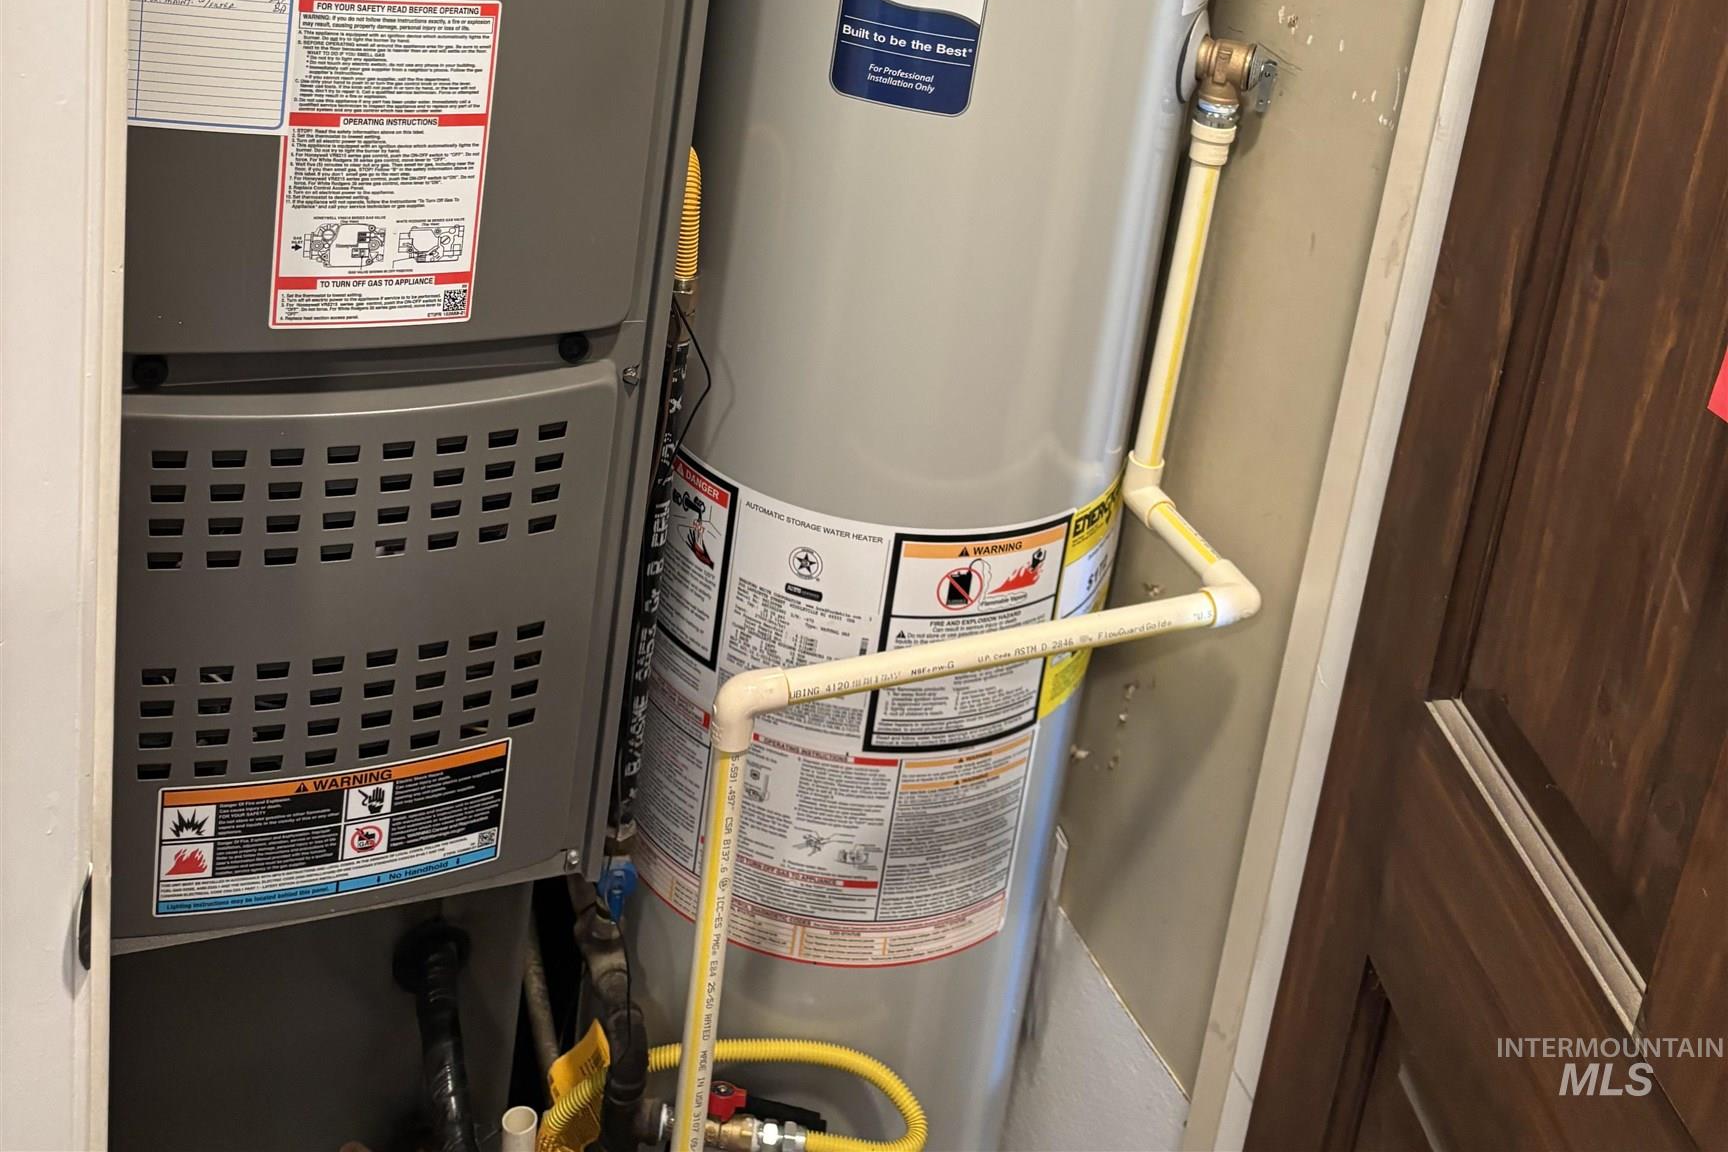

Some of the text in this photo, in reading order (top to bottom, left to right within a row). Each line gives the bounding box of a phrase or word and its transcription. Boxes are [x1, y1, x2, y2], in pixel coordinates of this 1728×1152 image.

[316, 2, 480, 15] FOR YOUR SAFETY READ BEFORE OPERATING
[842, 24, 968, 58] Built to be the Best
[869, 63, 934, 83] For Professional
[867, 73, 935, 94] Installation Only
[343, 118, 438, 126] OPERATING INSTRUCTIONS
[395, 277, 433, 285] APPLIANCE
[685, 470, 720, 500] DANGER
[746, 501, 884, 544] AUTOMATIC STORAGE WATER HEATER
[973, 541, 1022, 556] WARNING
[1052, 638, 1074, 649] 2846
[826, 681, 850, 693] 4120
[313, 769, 393, 792] WARNING
[725, 817, 733, 835] CSA
[405, 861, 448, 877] Handhold
[193, 899, 229, 909] instructions
[254, 894, 277, 903] located
[278, 892, 297, 900] behind
[715, 896, 725, 928] ICC-ES
[706, 982, 716, 1009] 25/50
[703, 1014, 712, 1041] RATED
[695, 1050, 707, 1108] MADE IN USA
